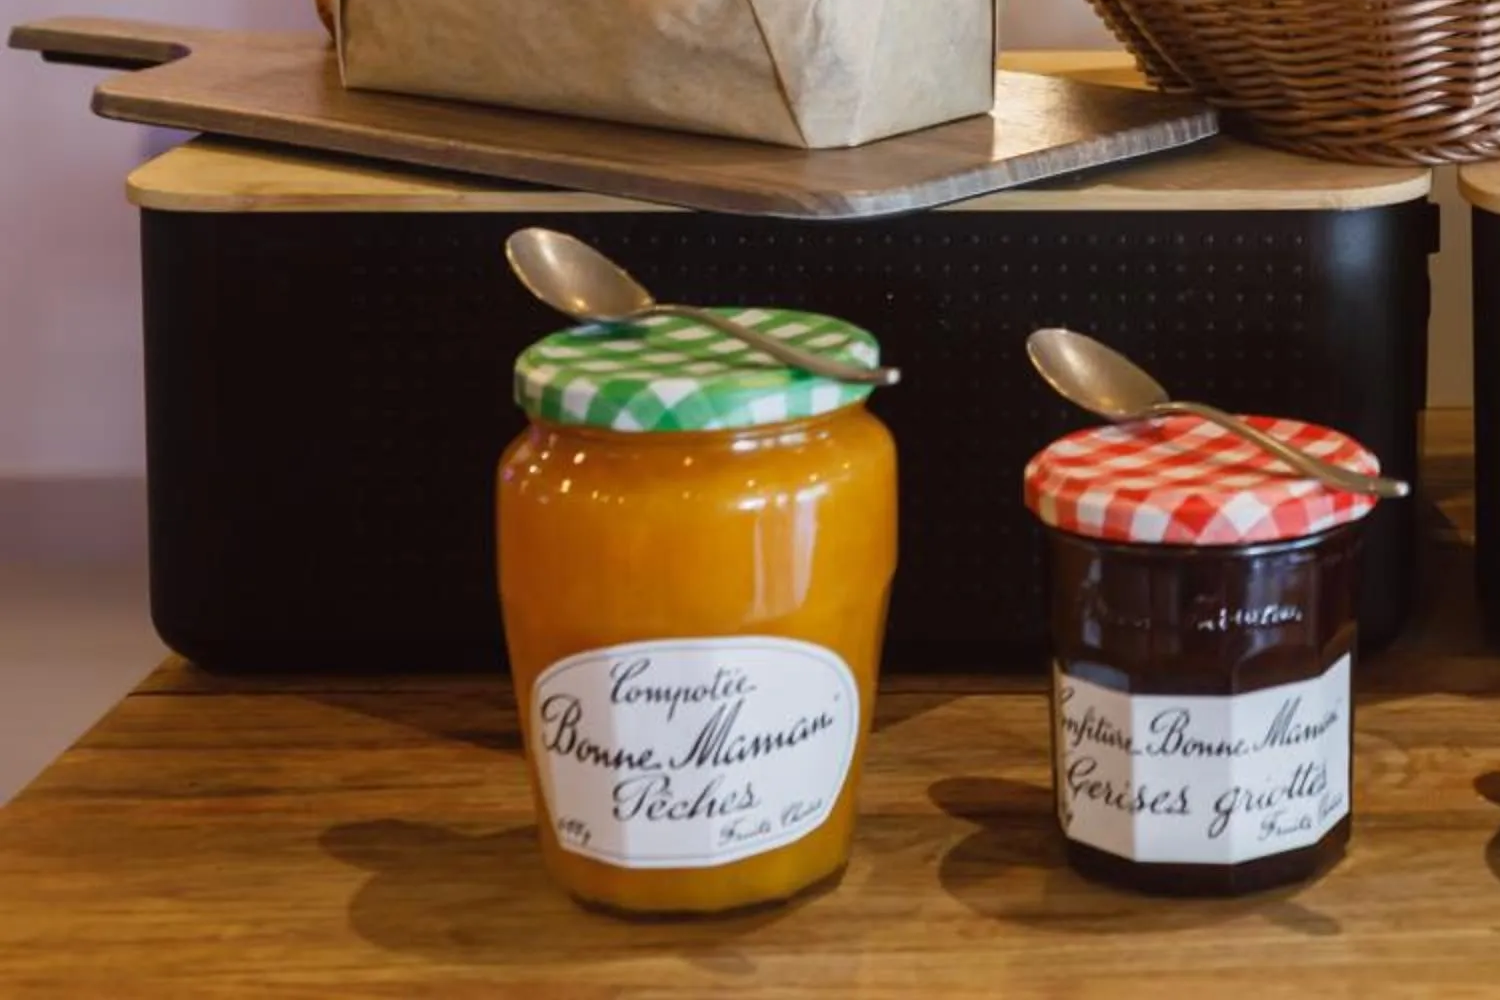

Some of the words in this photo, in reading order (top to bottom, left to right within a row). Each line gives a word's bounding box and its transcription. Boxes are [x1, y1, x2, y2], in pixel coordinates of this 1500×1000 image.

[540, 692, 664, 771] Bonne
[668, 696, 835, 770] Maman
[1146, 707, 1250, 758] Bonne
